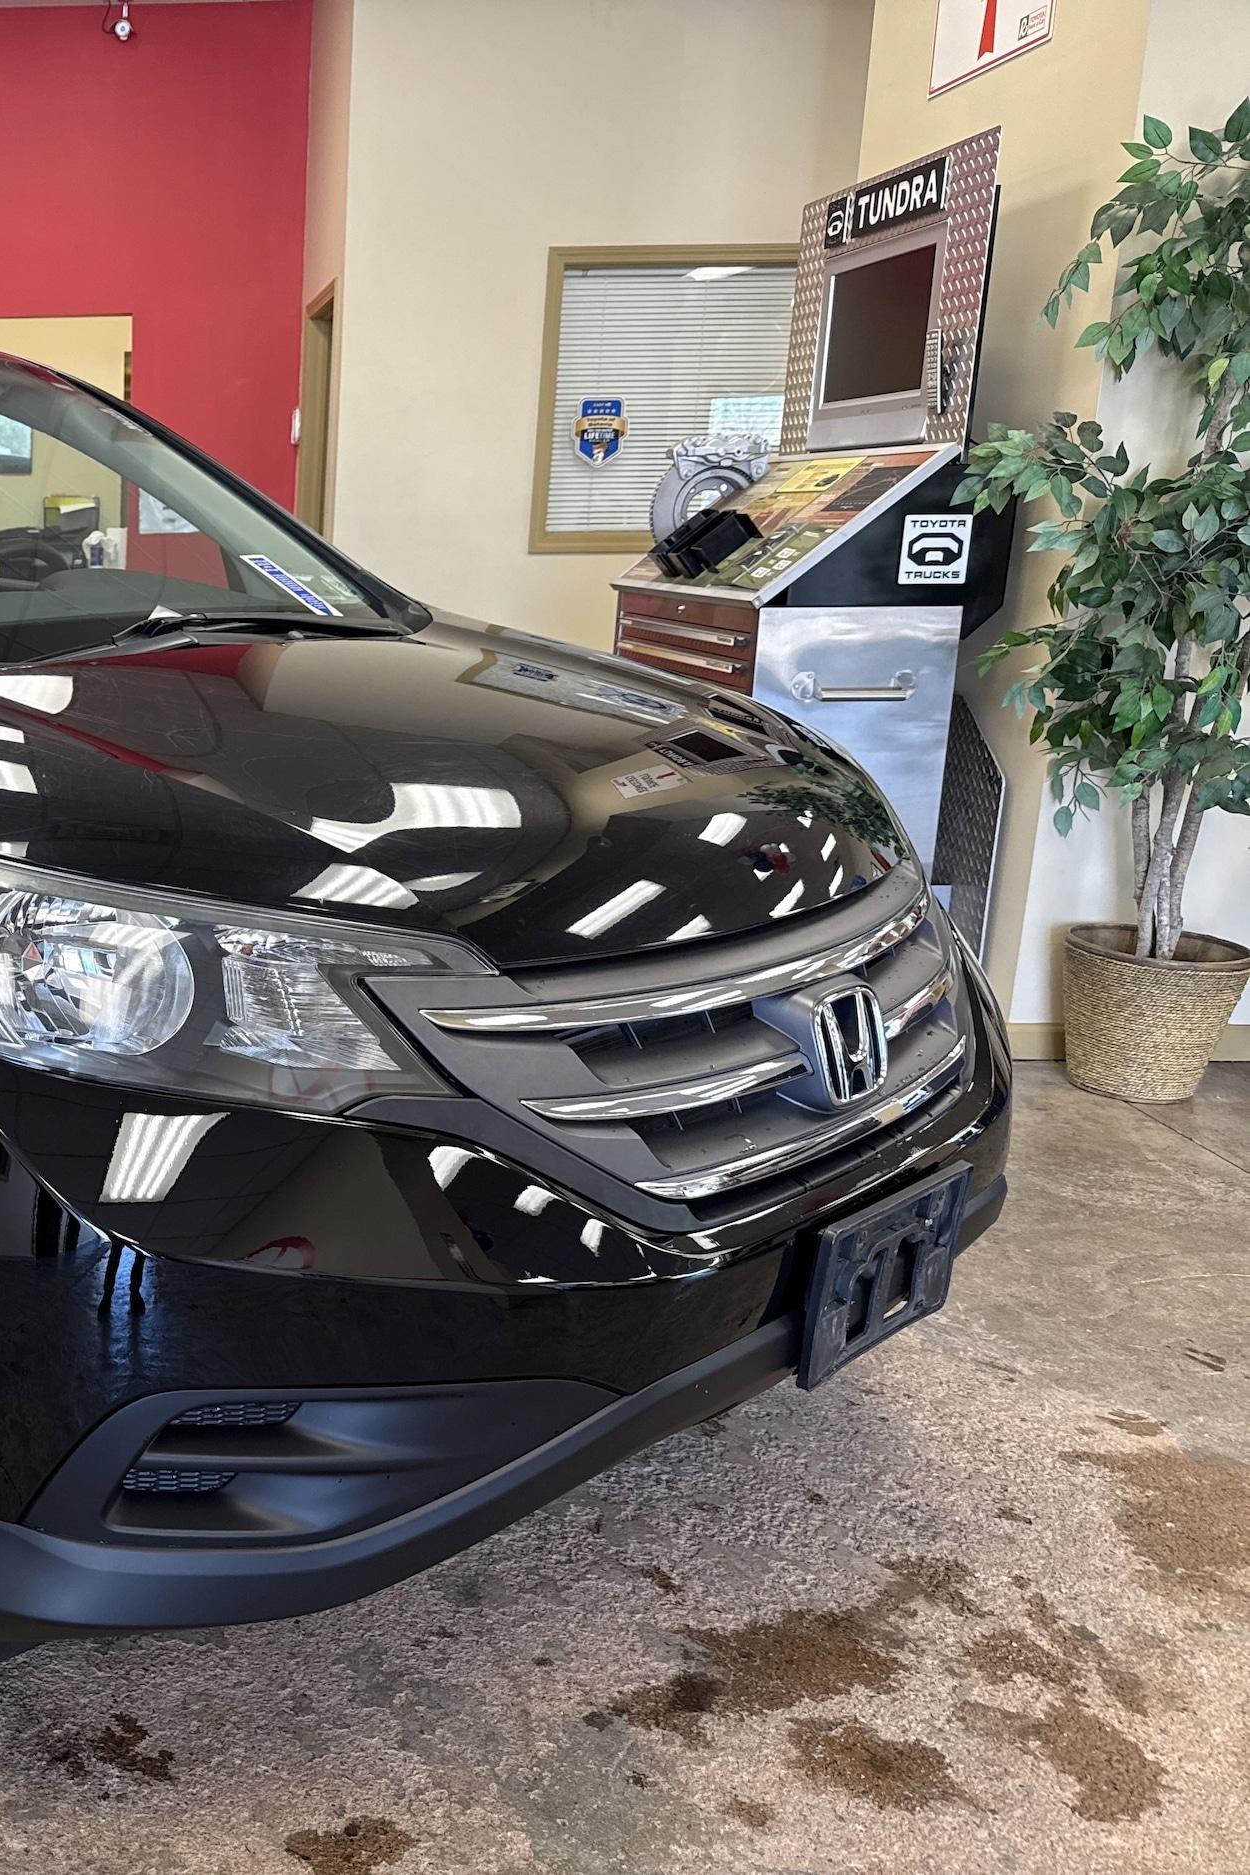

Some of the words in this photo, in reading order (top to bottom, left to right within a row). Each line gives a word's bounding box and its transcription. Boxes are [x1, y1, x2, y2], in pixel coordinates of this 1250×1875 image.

[858, 169, 938, 229] TUNDRA
[583, 431, 616, 440] LIFETIME
[910, 519, 967, 528] TOYOTA
[904, 570, 961, 579] TRUCKS
